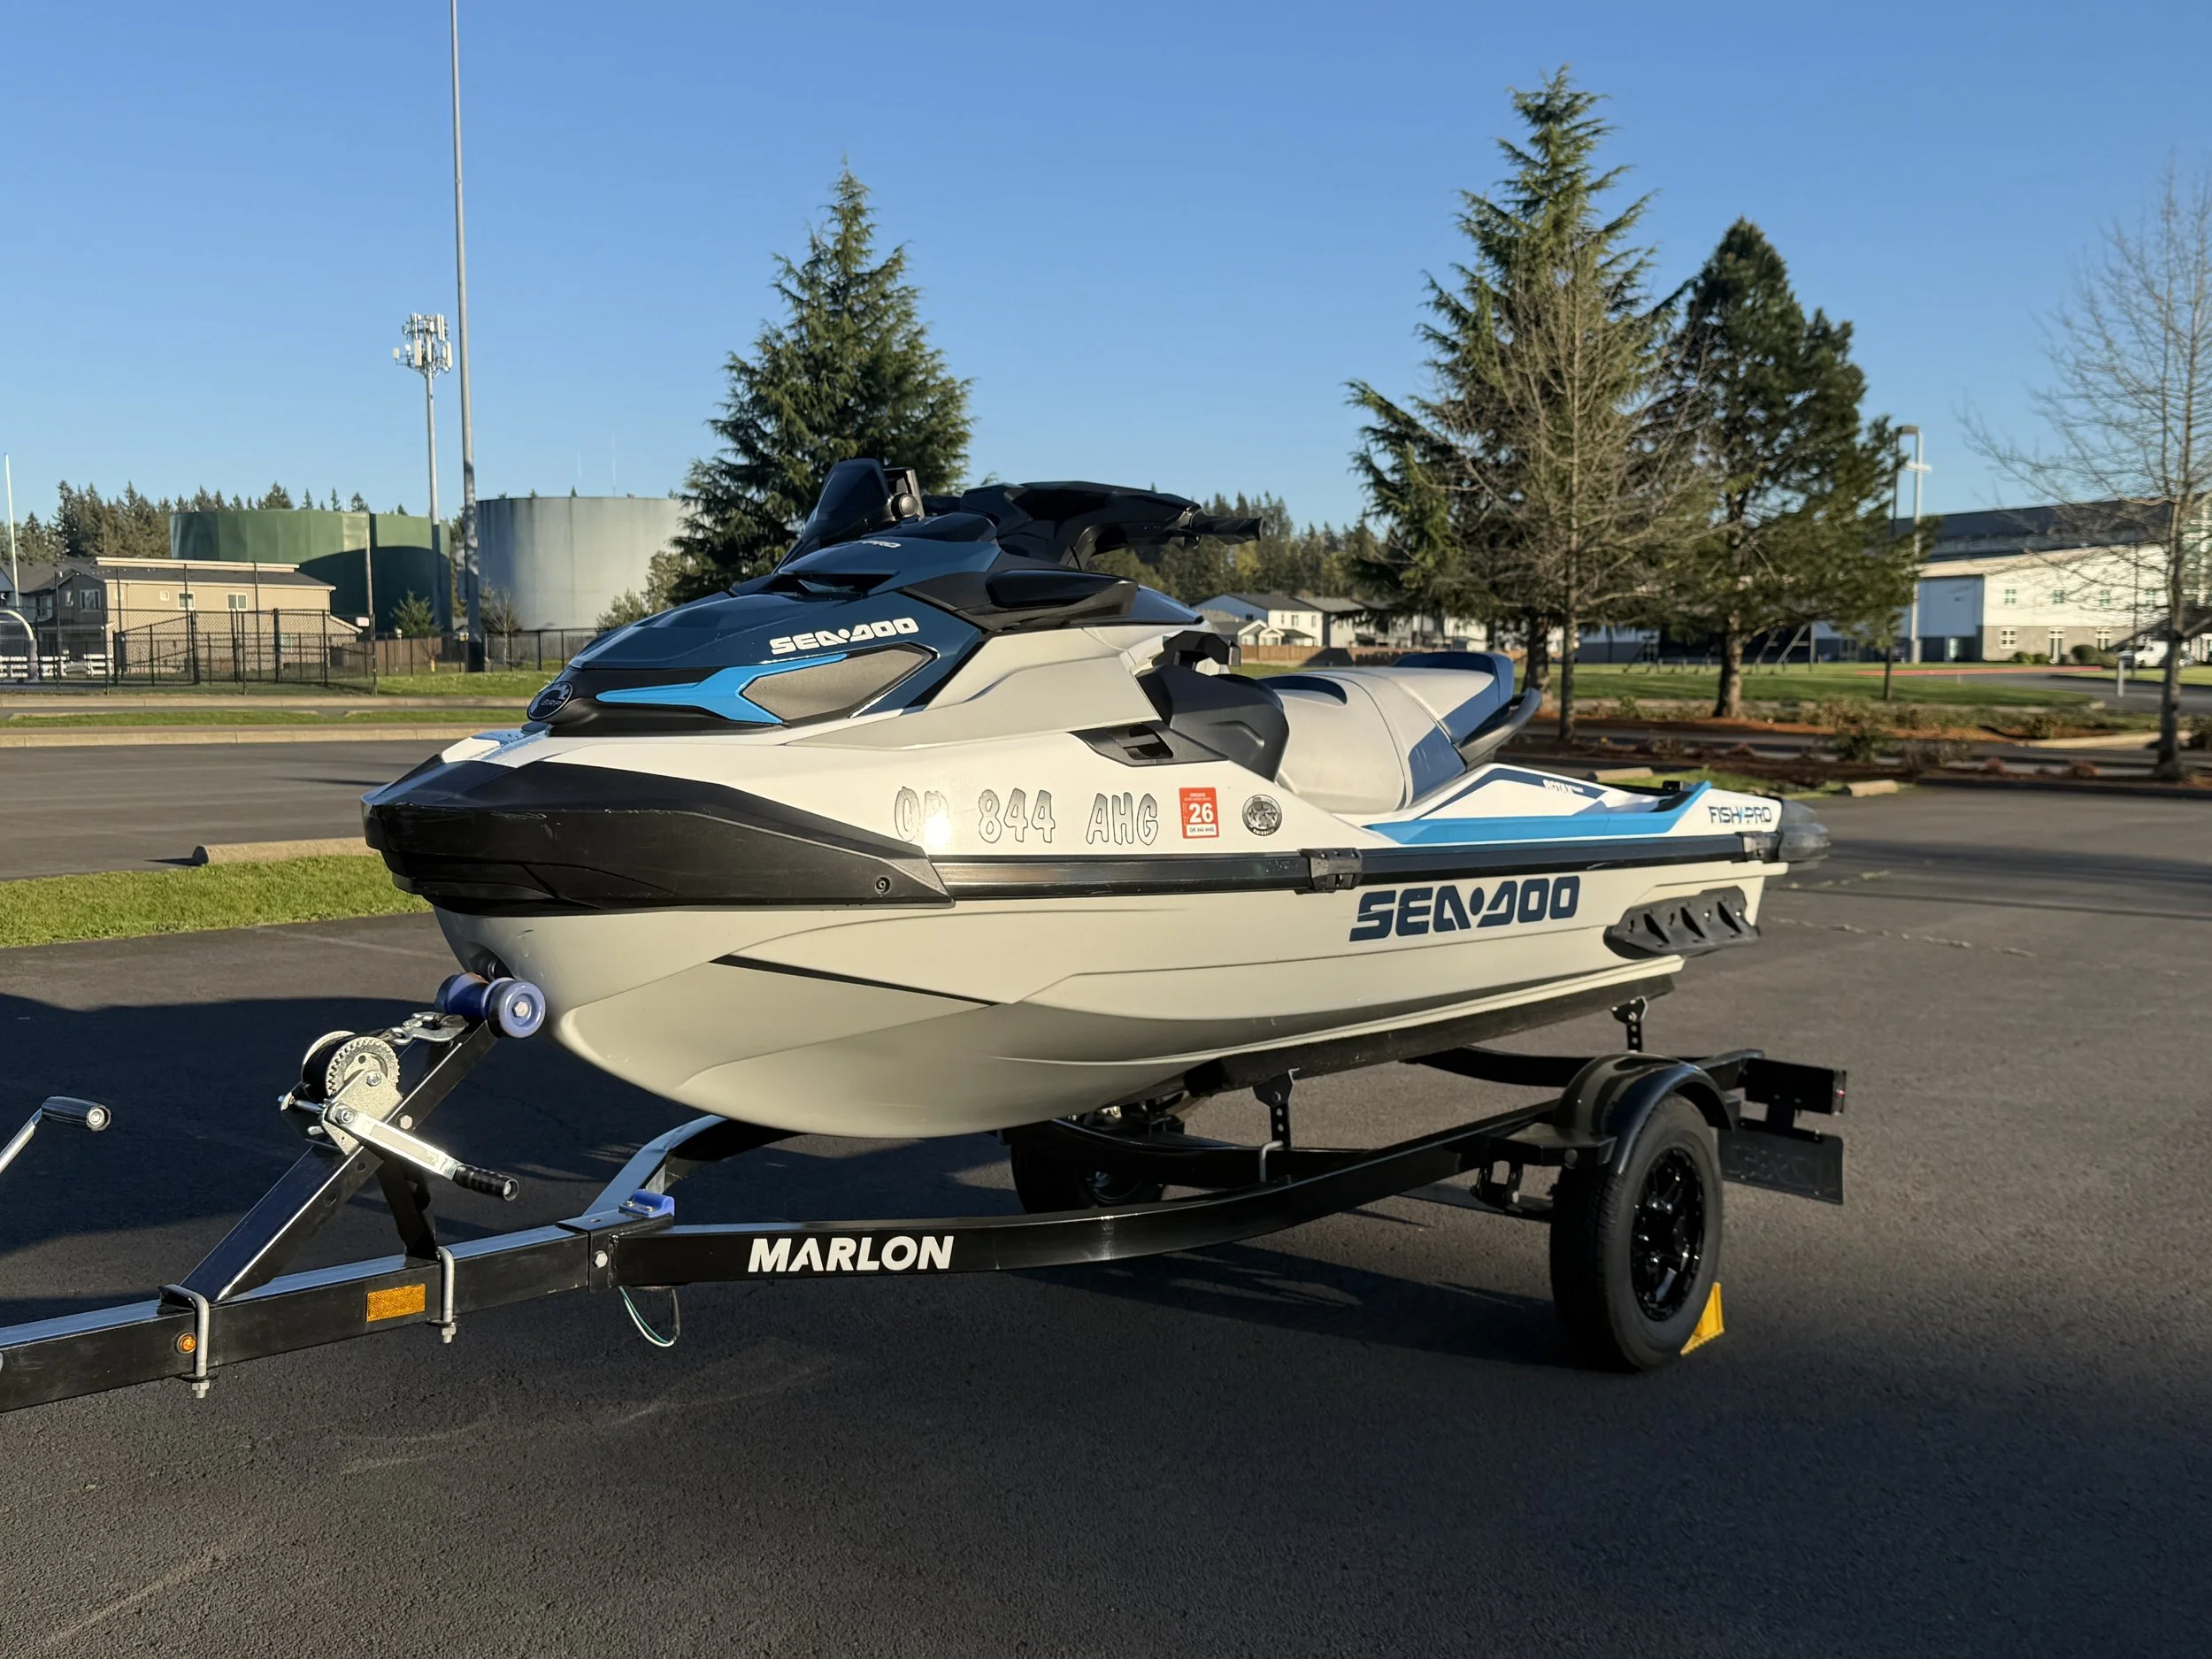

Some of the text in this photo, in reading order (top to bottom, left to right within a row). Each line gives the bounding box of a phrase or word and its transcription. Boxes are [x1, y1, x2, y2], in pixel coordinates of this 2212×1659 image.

[978, 787, 1056, 843] 844
[1086, 792, 1158, 846] AHG
[1188, 802, 1214, 824] 26
[748, 1235, 955, 1273] MARLON
